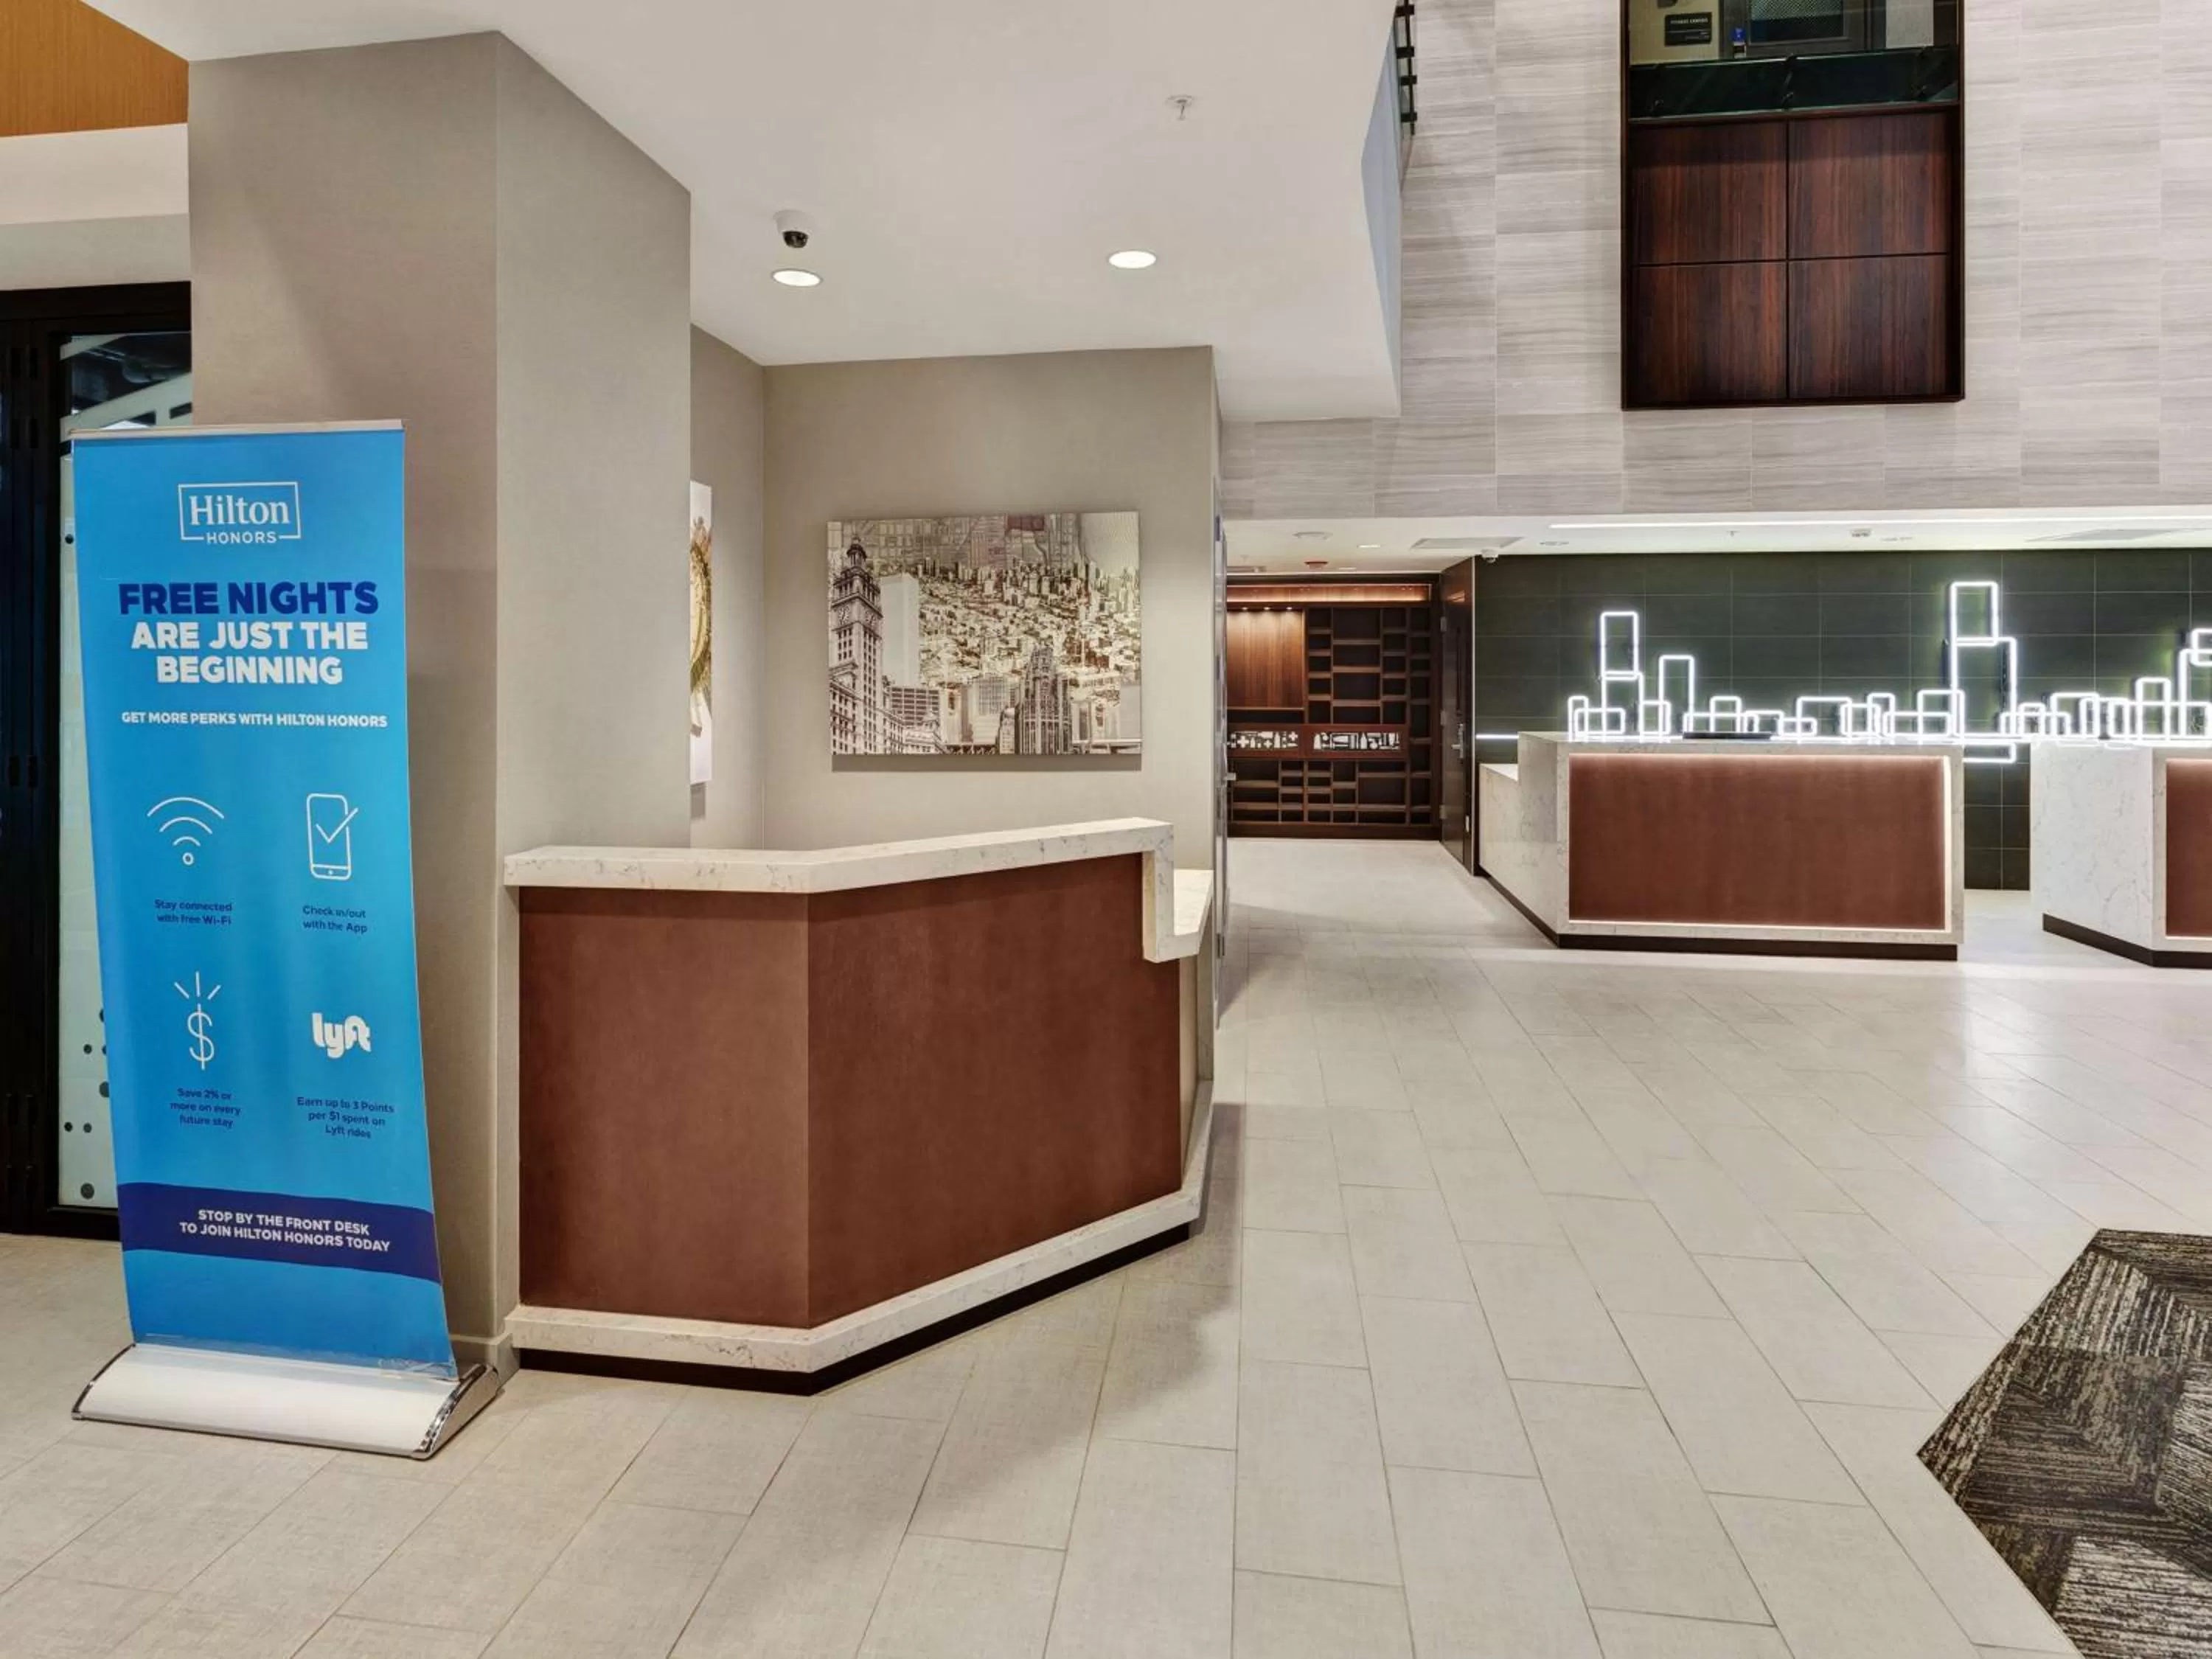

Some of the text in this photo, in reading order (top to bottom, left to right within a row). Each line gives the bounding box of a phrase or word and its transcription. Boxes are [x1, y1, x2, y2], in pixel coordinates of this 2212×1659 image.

[189, 494, 291, 526] Hilton
[206, 531, 277, 545] HONORS
[118, 580, 380, 615] FREE NIGHTS
[131, 622, 369, 650] ARE JUST THE
[156, 655, 344, 685] BEGINNING
[122, 712, 388, 728] GET MORE PERKS WITH HILTON HONORS
[154, 899, 232, 911] Stay connected
[302, 905, 366, 919] Check in/out
[202, 915, 232, 925] Wi-Fi
[303, 920, 367, 935] with the App
[296, 1096, 323, 1107] Earn
[325, 1099, 339, 1109] up
[340, 1099, 350, 1109] to
[361, 1100, 395, 1113] Points
[307, 1111, 326, 1121] per
[341, 1113, 369, 1124] spent
[372, 1117, 386, 1126] on
[325, 1123, 346, 1136] Lyft
[198, 1209, 370, 1237] STOP BY THE FRONT DESK
[179, 1221, 391, 1253] TO JOIN HILTON HONORS TODAY
